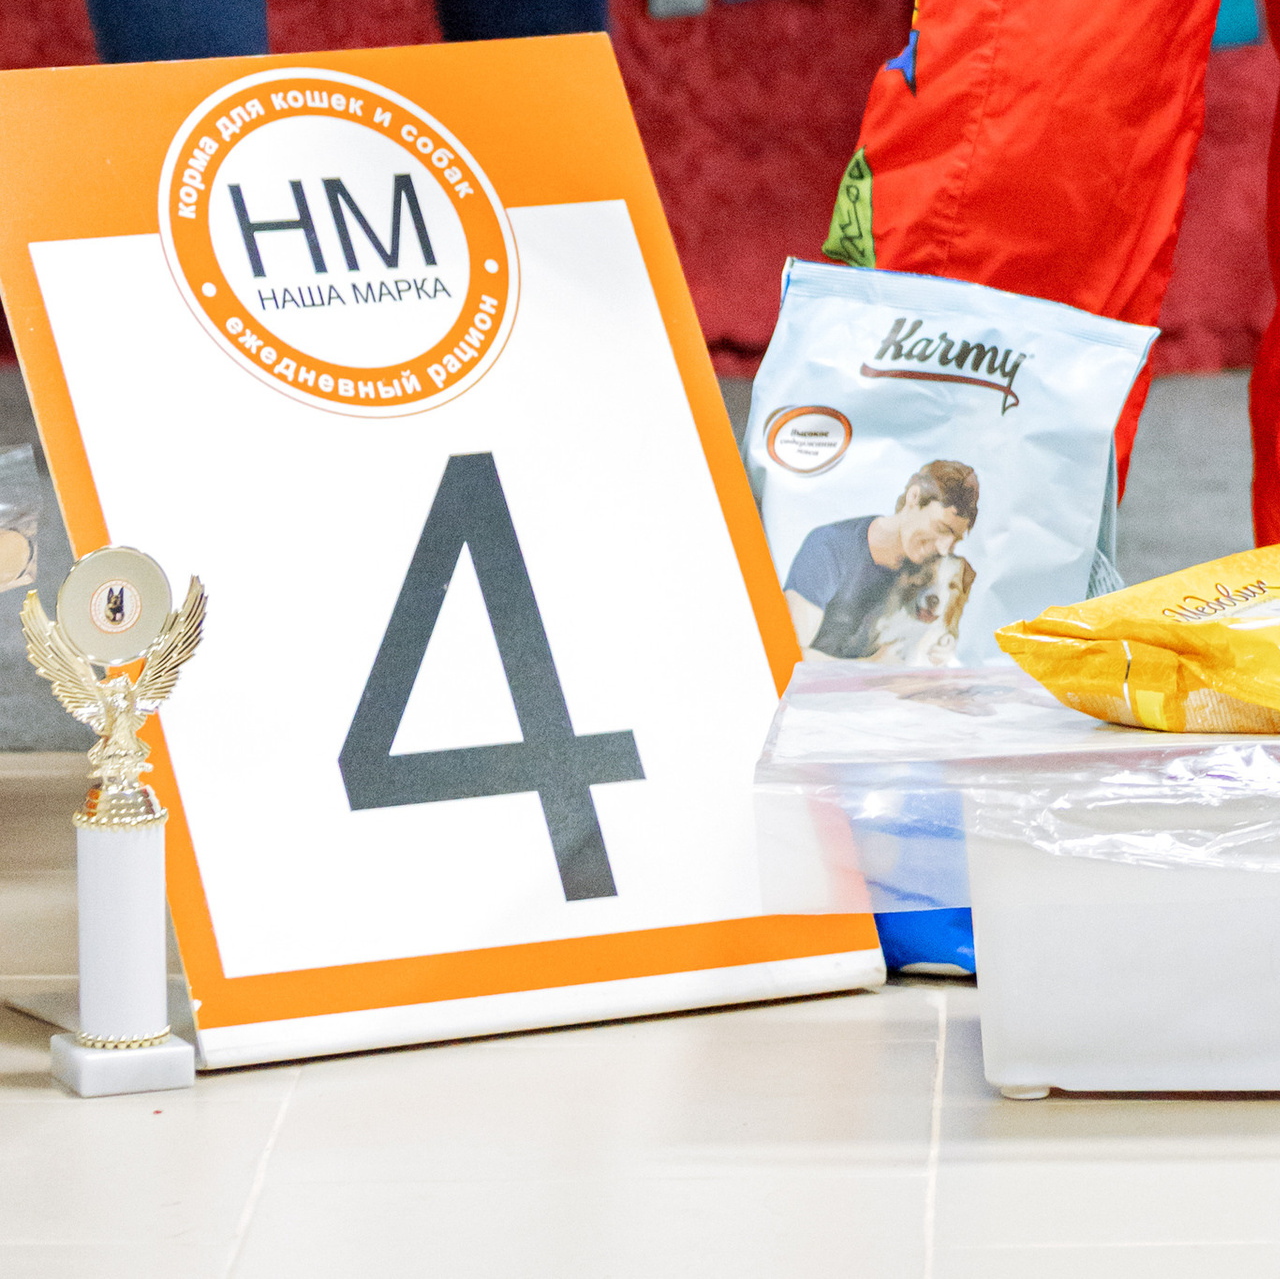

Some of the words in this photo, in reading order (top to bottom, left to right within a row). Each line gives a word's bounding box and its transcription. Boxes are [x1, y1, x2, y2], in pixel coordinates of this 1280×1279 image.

[177, 135, 219, 219] корма
[215, 98, 266, 142] для
[270, 89, 364, 117] кошек
[373, 106, 392, 128] и
[400, 124, 475, 199] собак
[227, 173, 437, 278] НМ
[225, 316, 422, 399] ежедневный
[426, 293, 499, 388] рацион
[258, 284, 346, 311] НАША
[351, 277, 452, 305] МАРКА
[873, 317, 1028, 417] Karmy
[338, 451, 646, 901] 4
